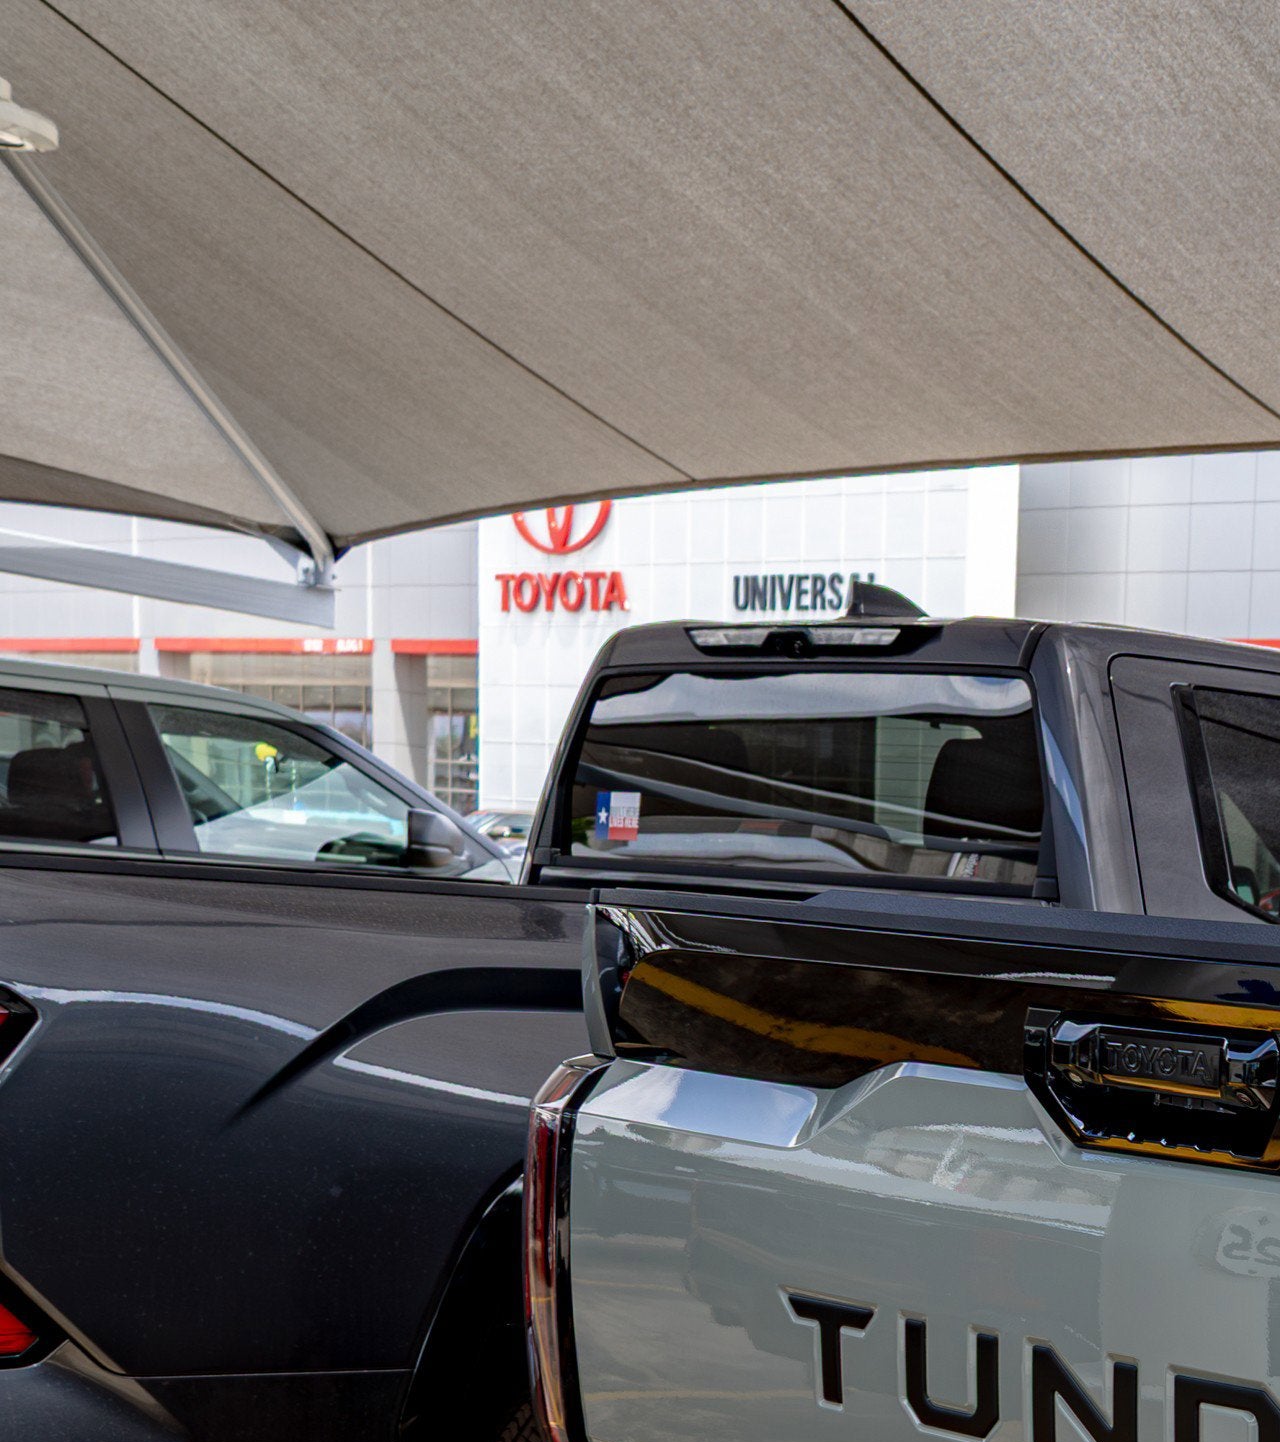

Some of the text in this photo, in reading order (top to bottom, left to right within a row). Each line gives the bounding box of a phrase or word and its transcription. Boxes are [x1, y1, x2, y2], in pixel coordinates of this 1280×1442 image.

[495, 570, 629, 612] TOYOTA
[733, 572, 876, 612] UNIVERS
[1103, 1041, 1212, 1080] TOYOTA
